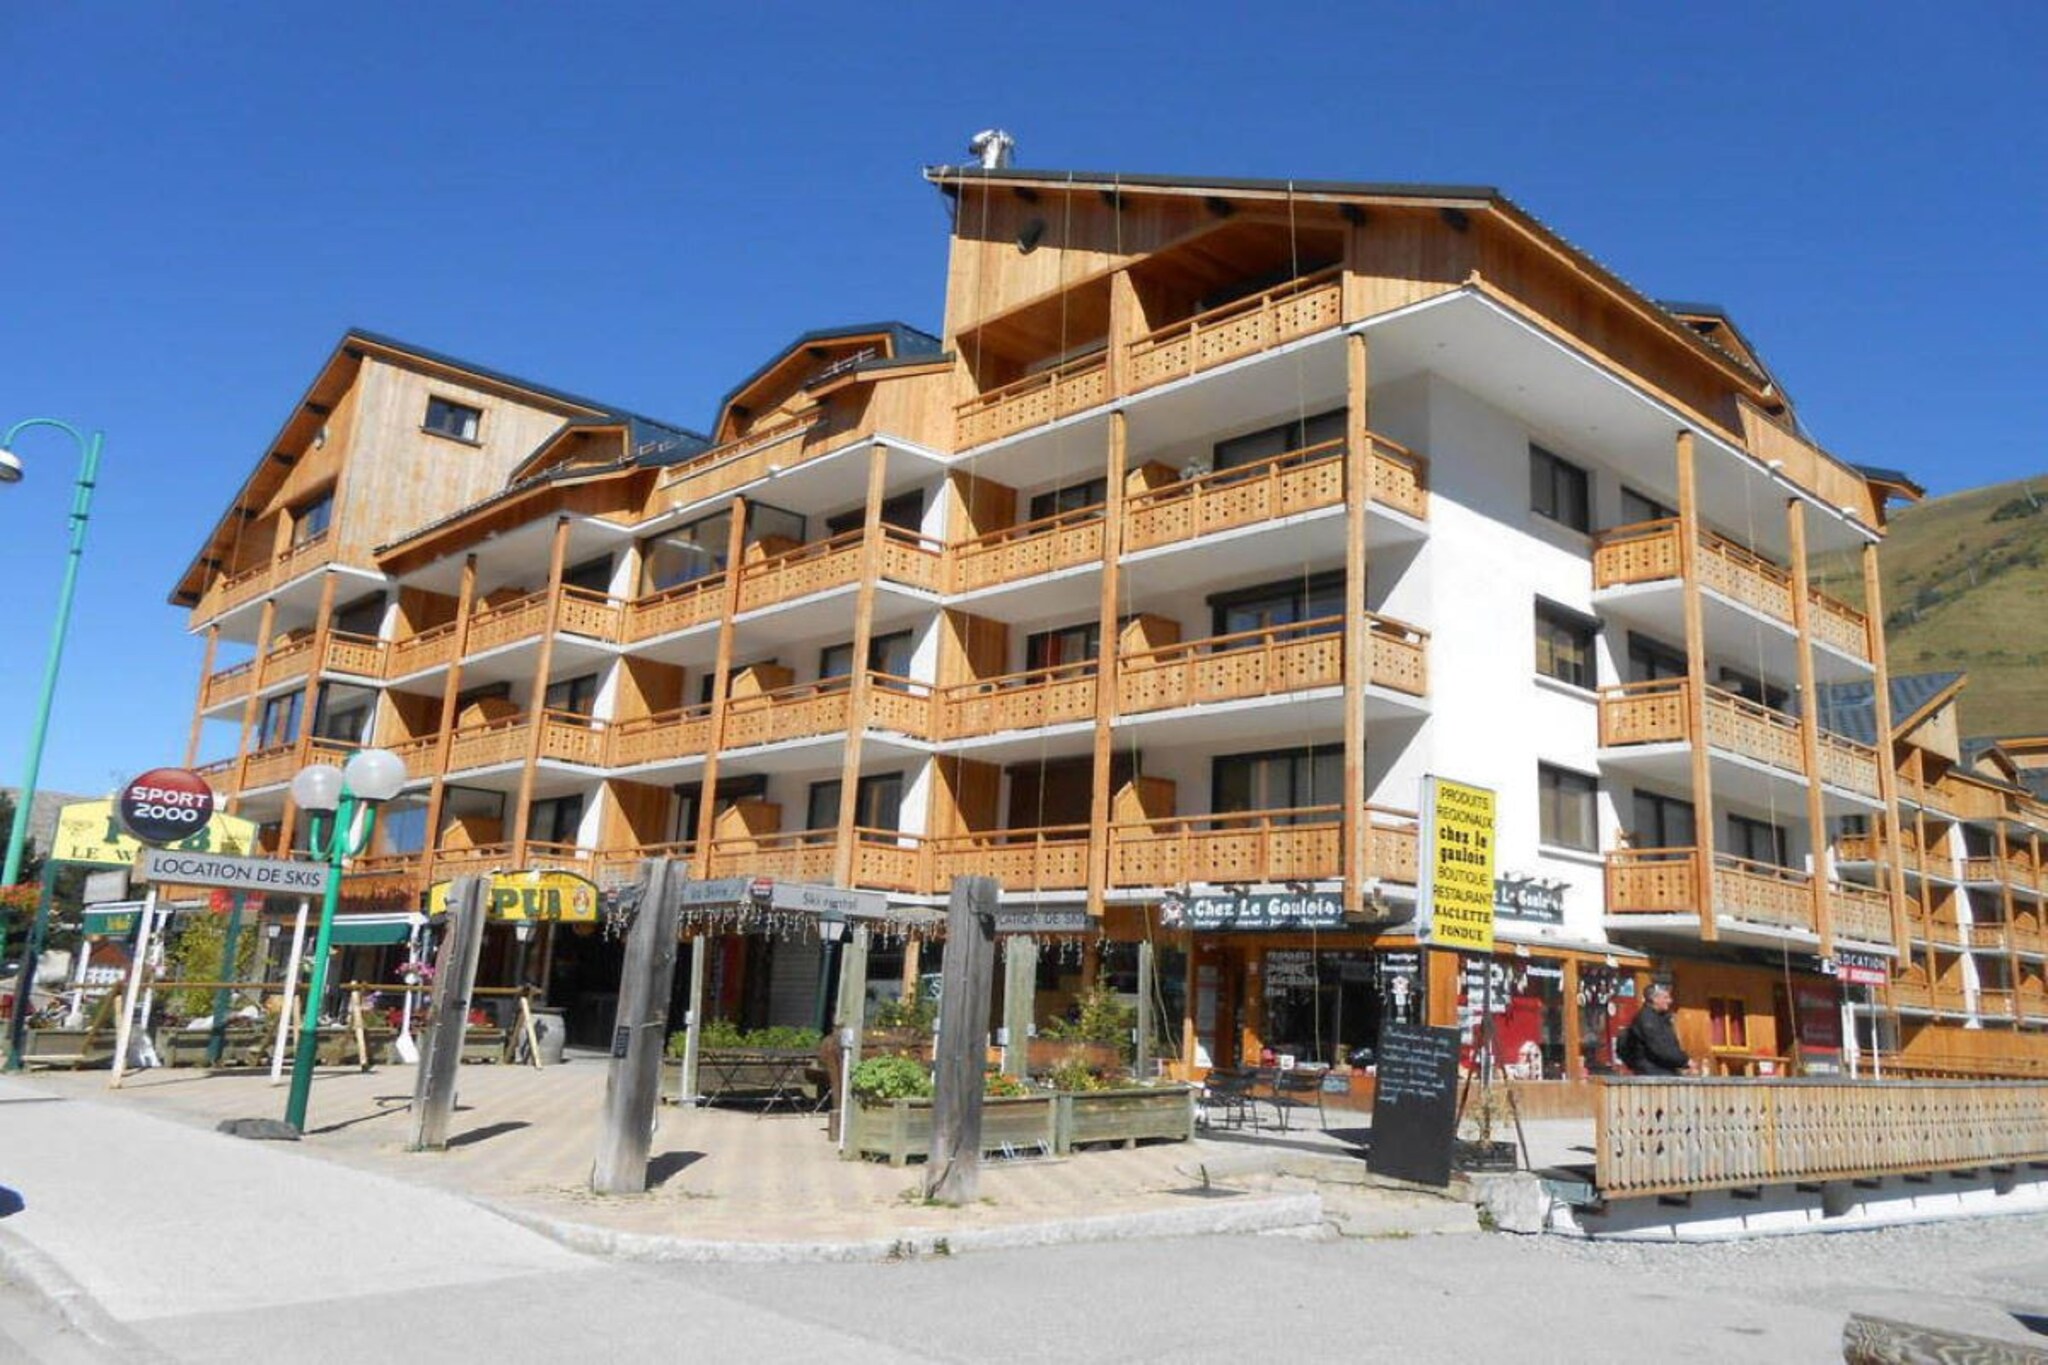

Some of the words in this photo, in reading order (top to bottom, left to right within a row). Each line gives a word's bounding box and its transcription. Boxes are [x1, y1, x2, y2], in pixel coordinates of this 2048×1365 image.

[131, 785, 209, 809] SPORT
[1441, 786, 1489, 810] PRODUITS
[133, 802, 198, 823] 2000
[1440, 826, 1469, 845] chez
[1475, 830, 1487, 849] le
[71, 846, 99, 860] LE
[1440, 846, 1486, 867] gaulois
[153, 857, 252, 881] LOCATION
[256, 868, 280, 884] DE
[283, 871, 321, 888] SKIS
[1437, 866, 1489, 887] BOUTIQUE
[1433, 884, 1493, 908] RESTAURANT
[1194, 898, 1234, 917] Chez
[1240, 898, 1261, 917] Le
[1267, 897, 1336, 917] Gaulois
[1434, 903, 1491, 924] RACLETTE
[1440, 924, 1484, 942] FONDUE
